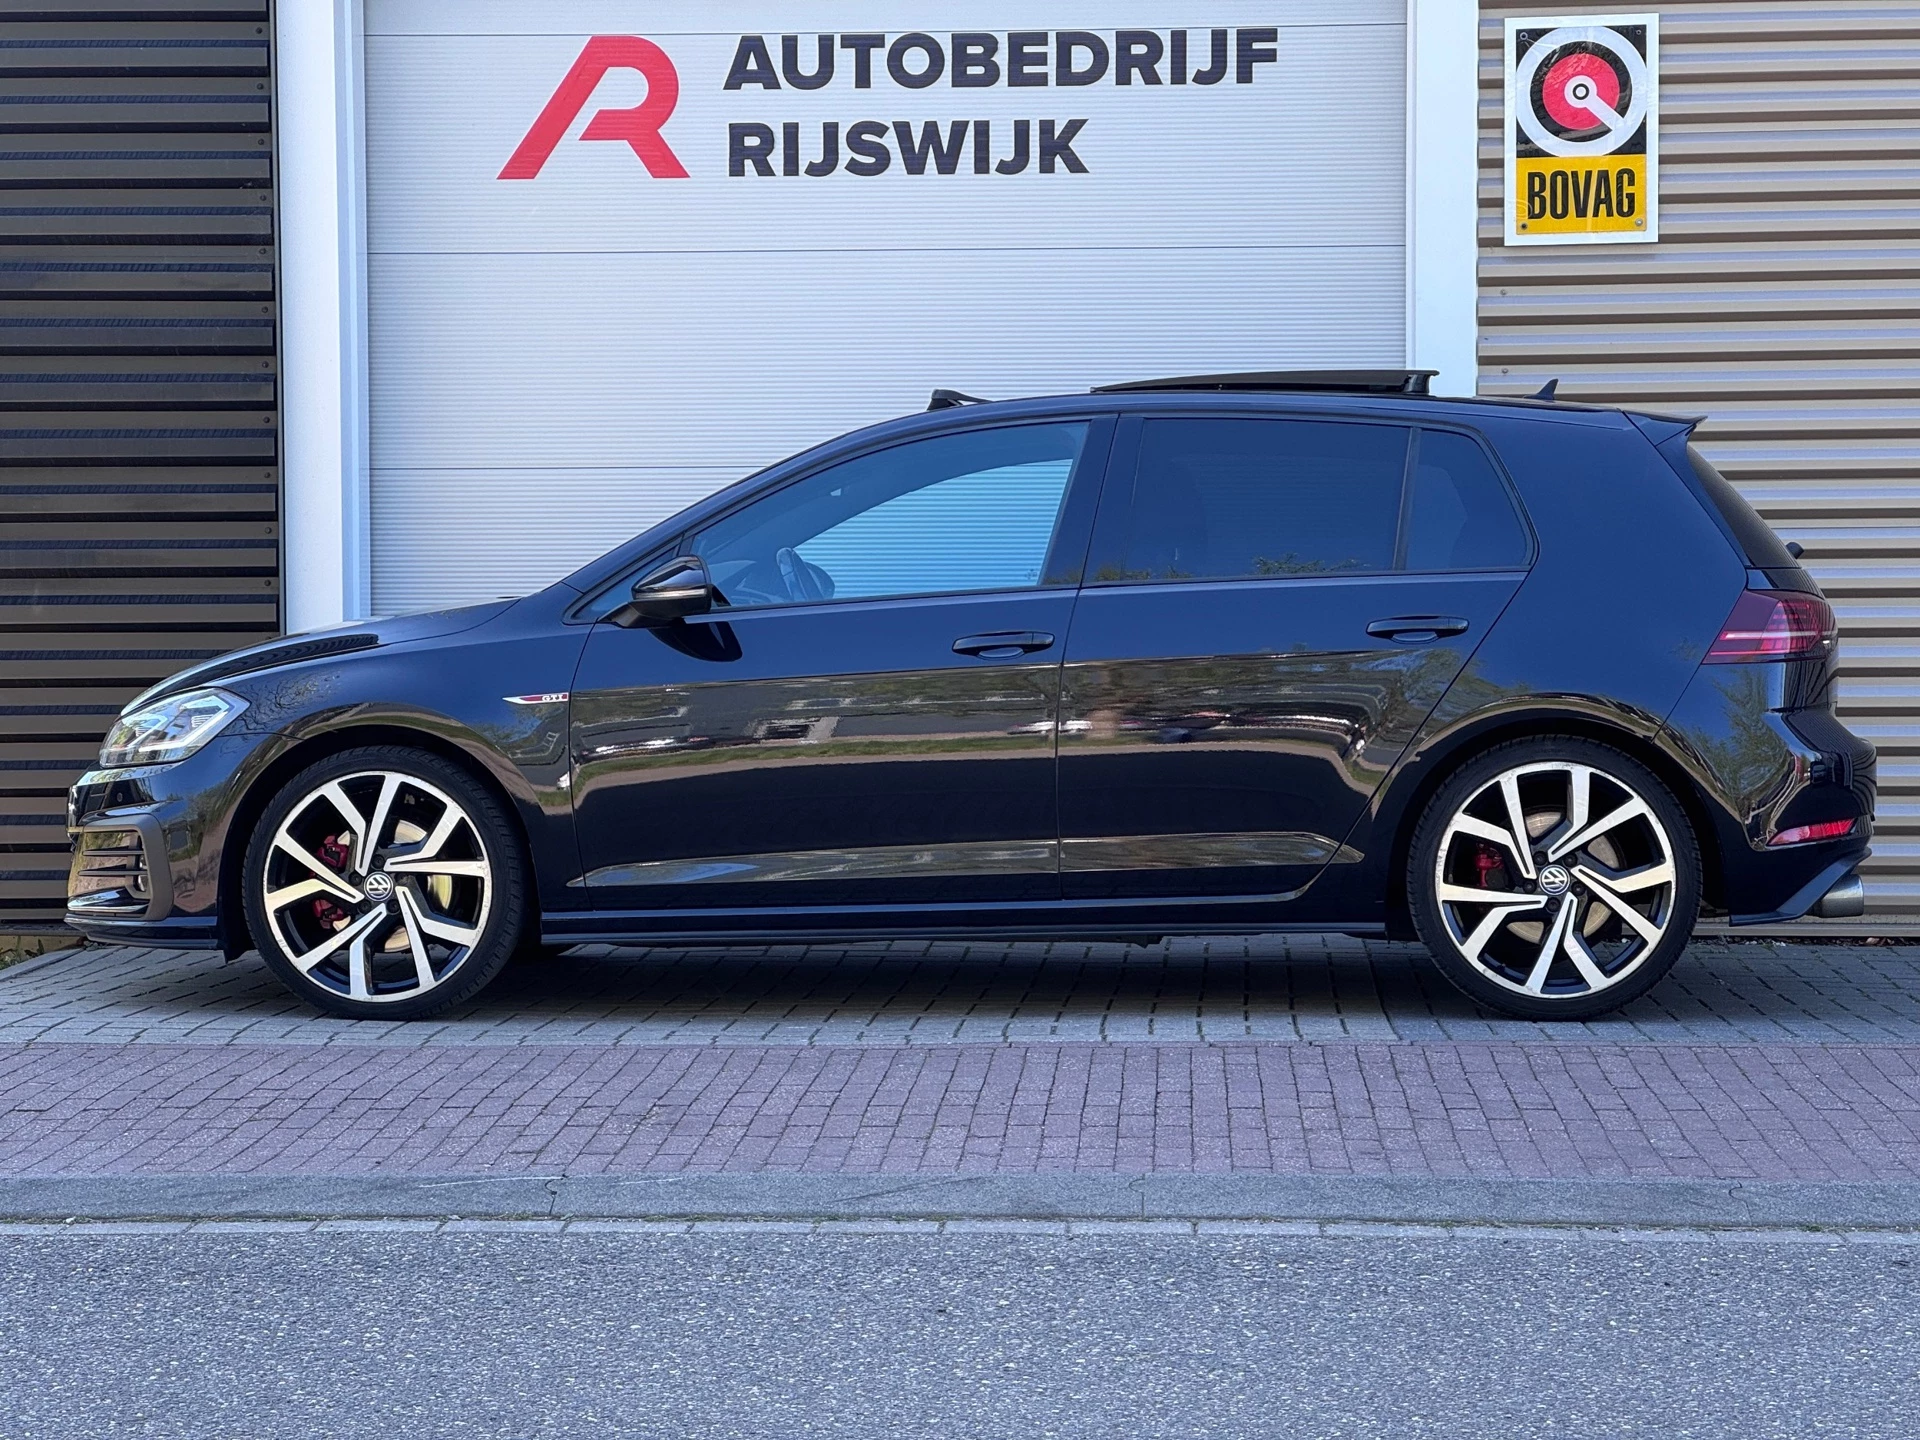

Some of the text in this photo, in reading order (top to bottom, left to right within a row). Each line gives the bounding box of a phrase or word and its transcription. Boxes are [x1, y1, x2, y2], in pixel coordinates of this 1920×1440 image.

[723, 28, 1277, 90] AUTOBEDRIJF
[728, 119, 1089, 177] RIJSWIJK
[1527, 168, 1636, 220] BOVAG
